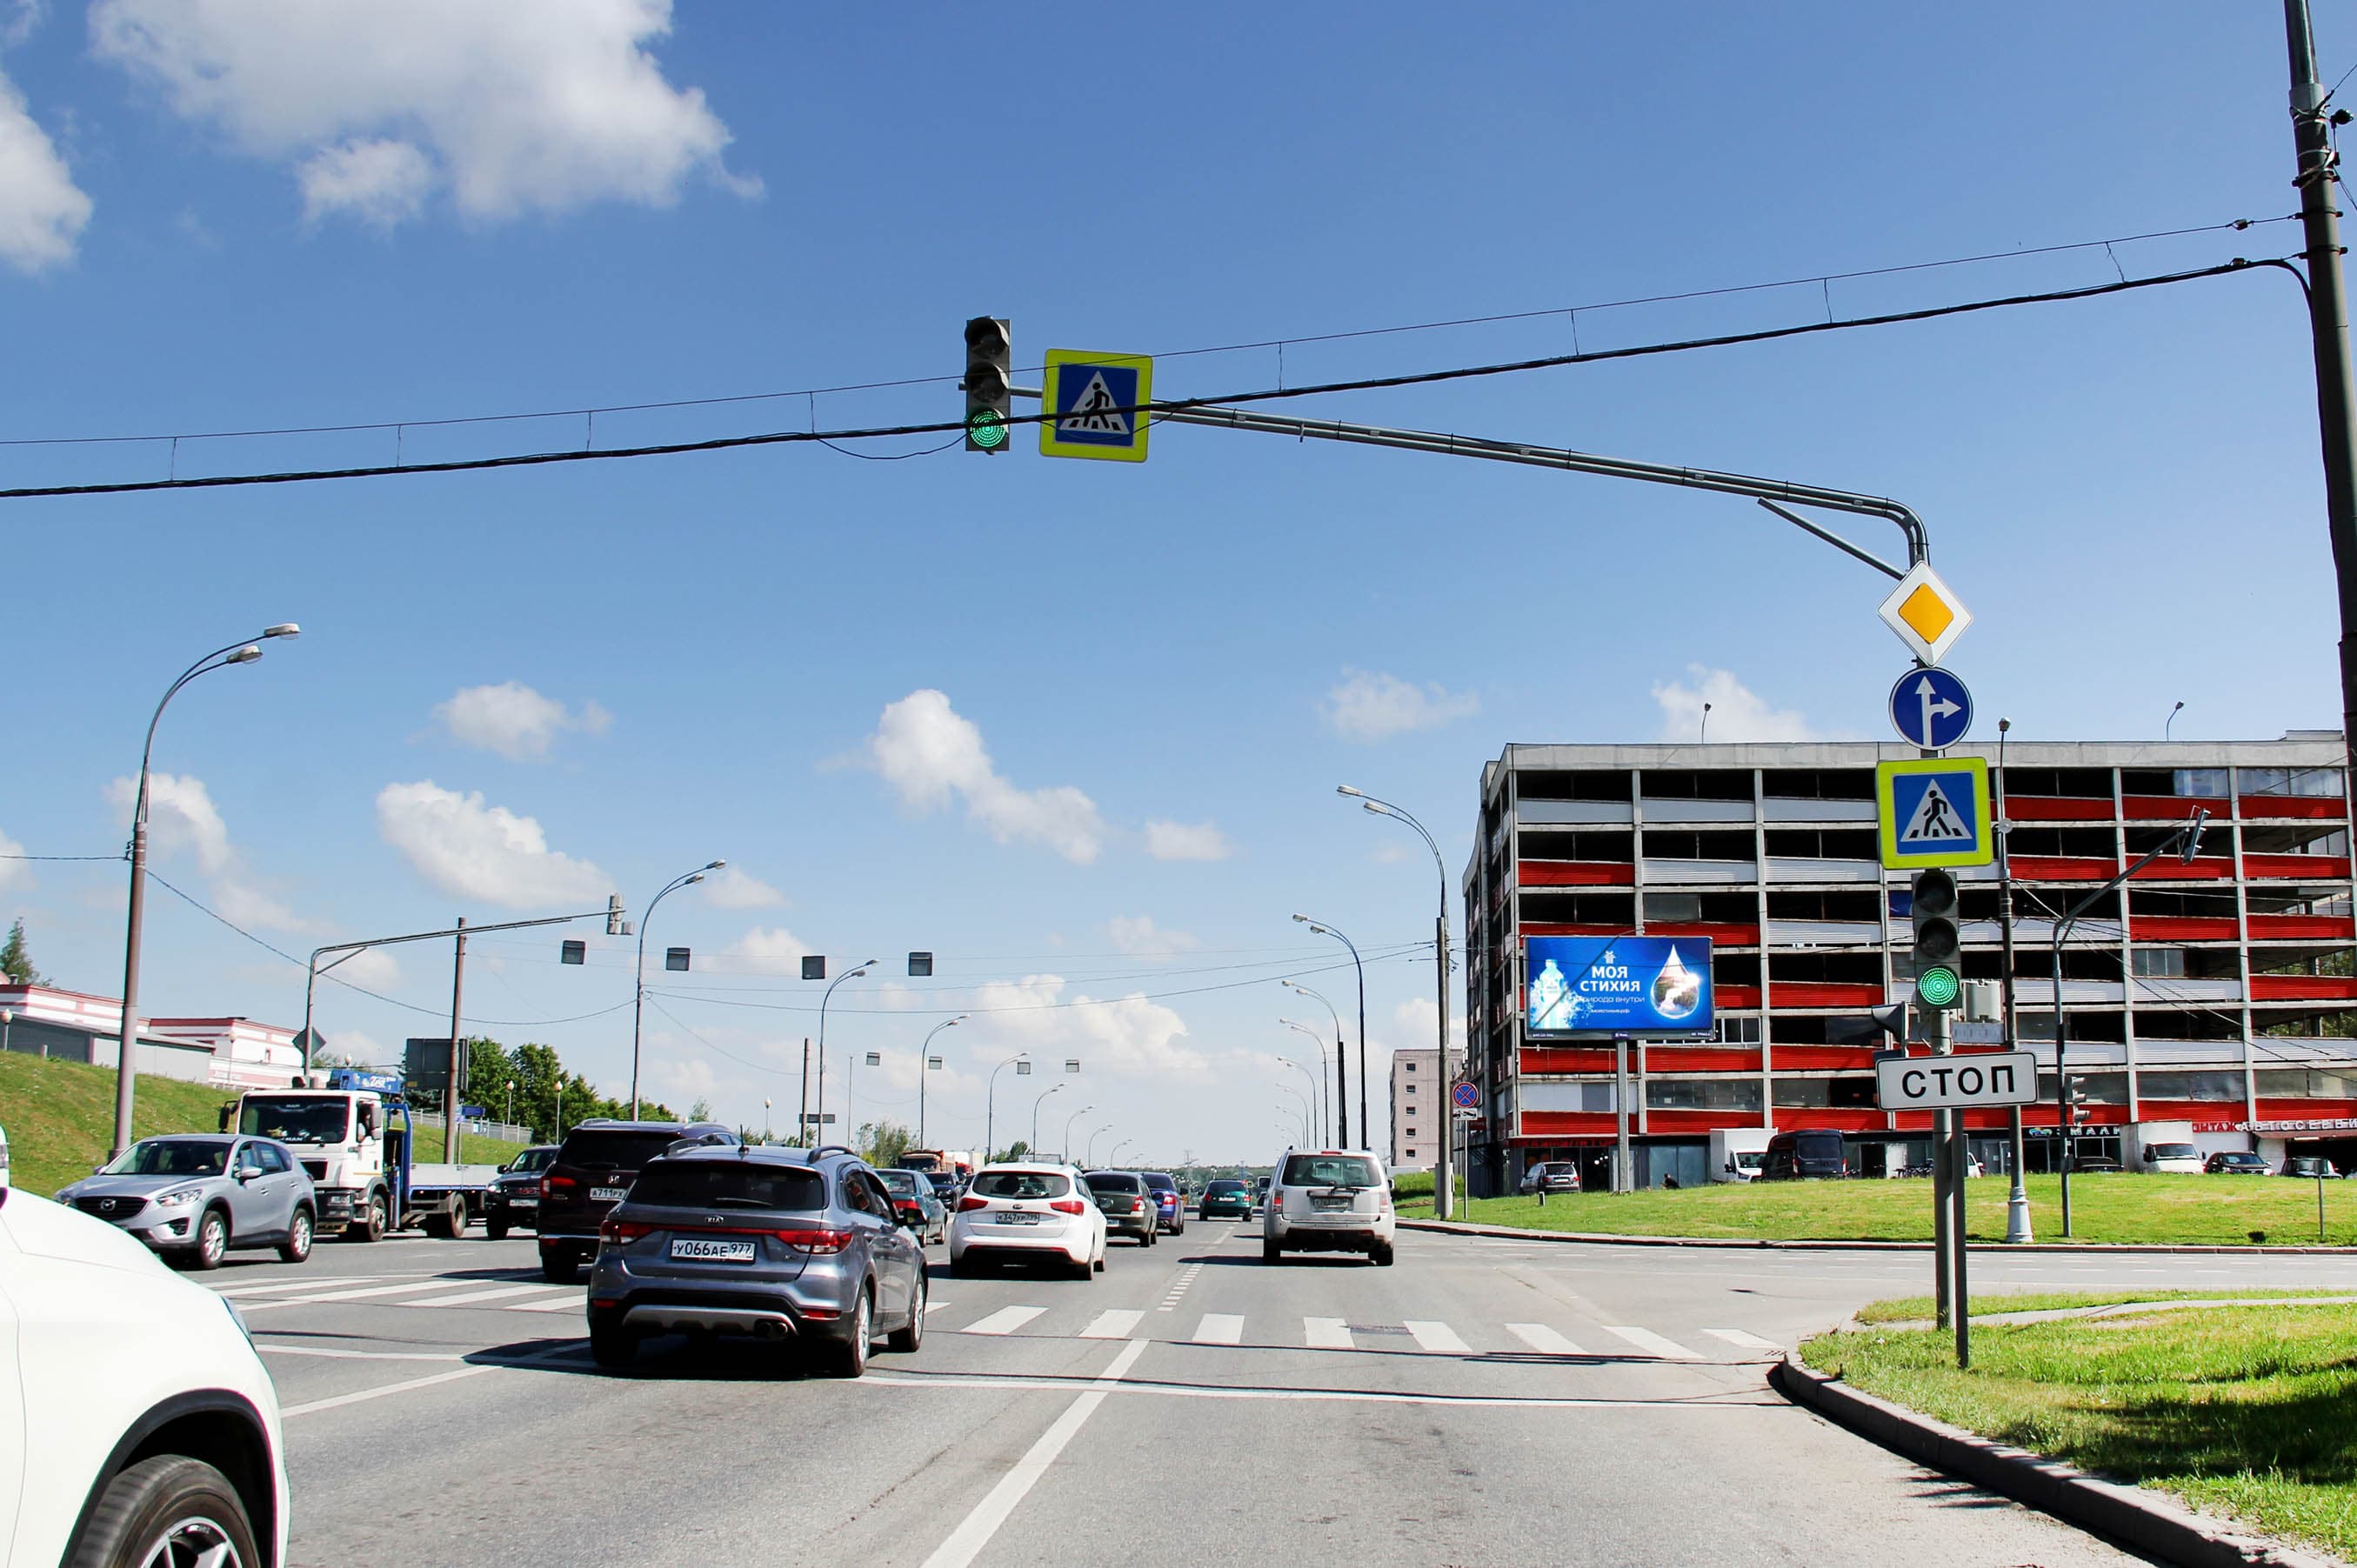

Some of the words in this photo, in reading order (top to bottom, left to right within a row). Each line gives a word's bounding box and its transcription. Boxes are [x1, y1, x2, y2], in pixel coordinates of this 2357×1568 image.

[1592, 965, 1627, 978] МОЯ
[1579, 980, 1640, 991] СТИХИЯ
[1901, 1064, 2014, 1098] СТОП
